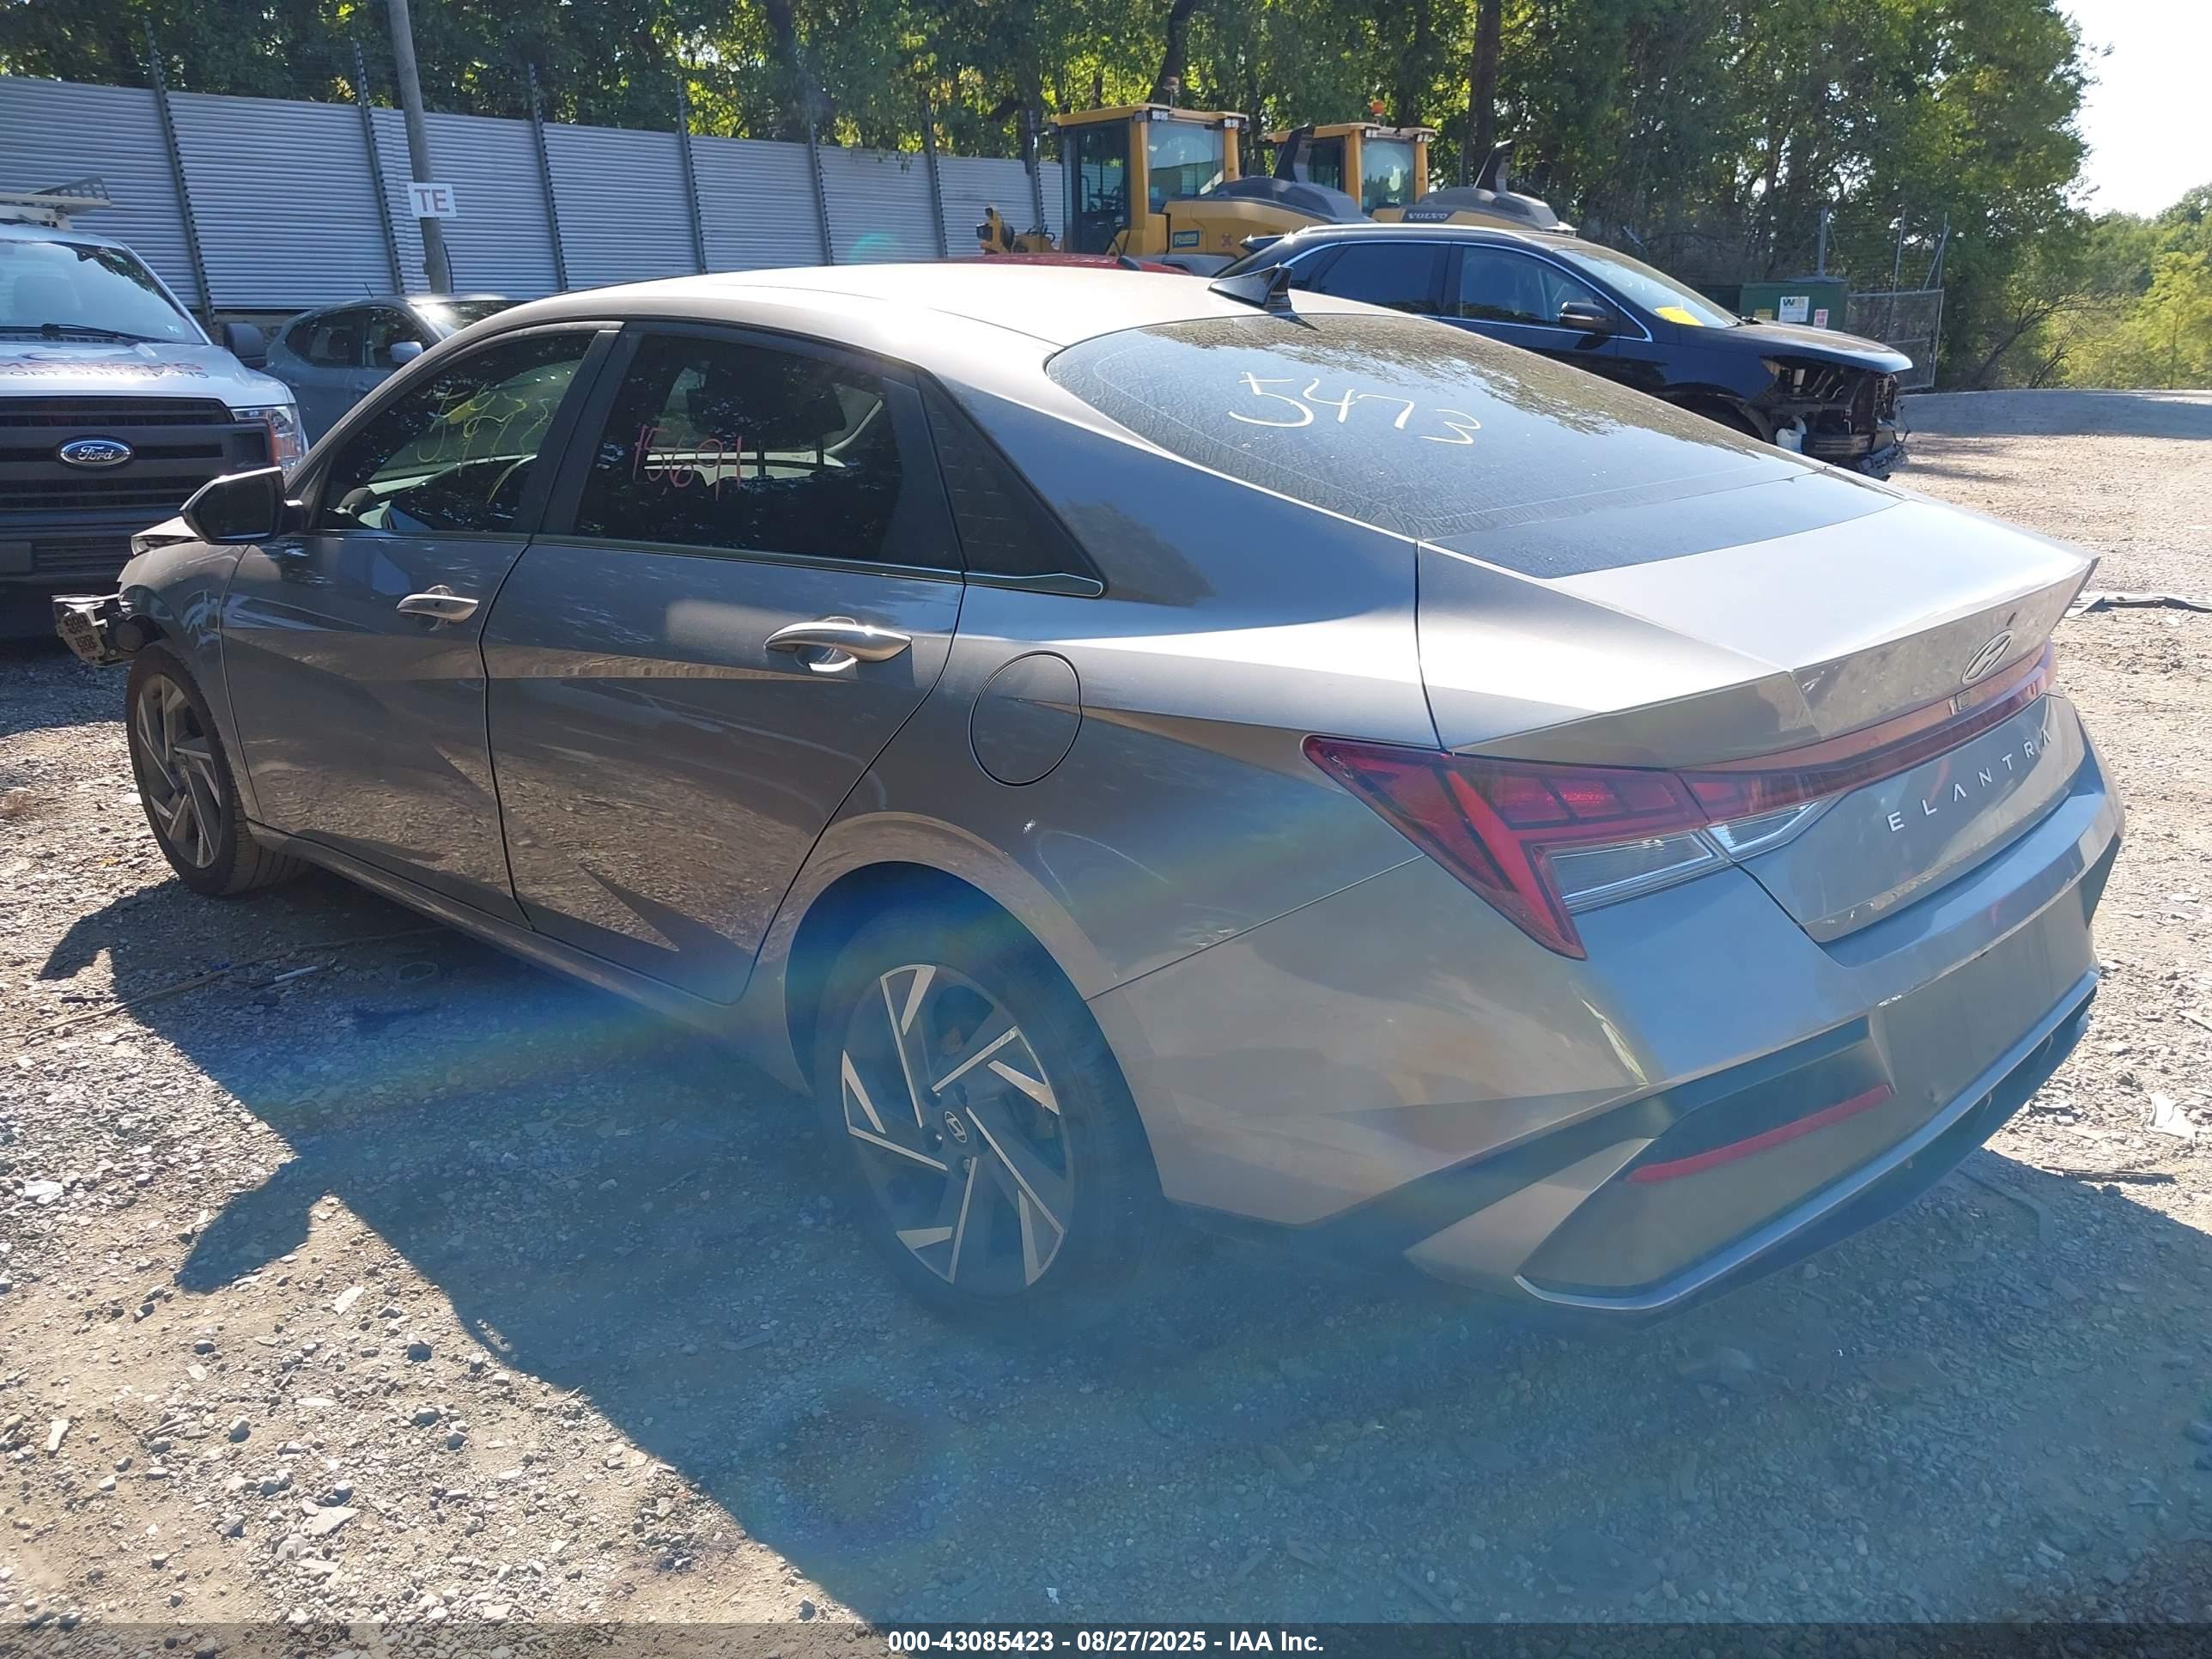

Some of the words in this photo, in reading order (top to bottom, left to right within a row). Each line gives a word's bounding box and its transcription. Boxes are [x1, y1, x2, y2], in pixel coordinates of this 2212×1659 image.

[414, 188, 450, 212] TE
[1228, 371, 1481, 445] 5473
[77, 446, 115, 460] Ford
[1887, 729, 2051, 832] ELANTRA
